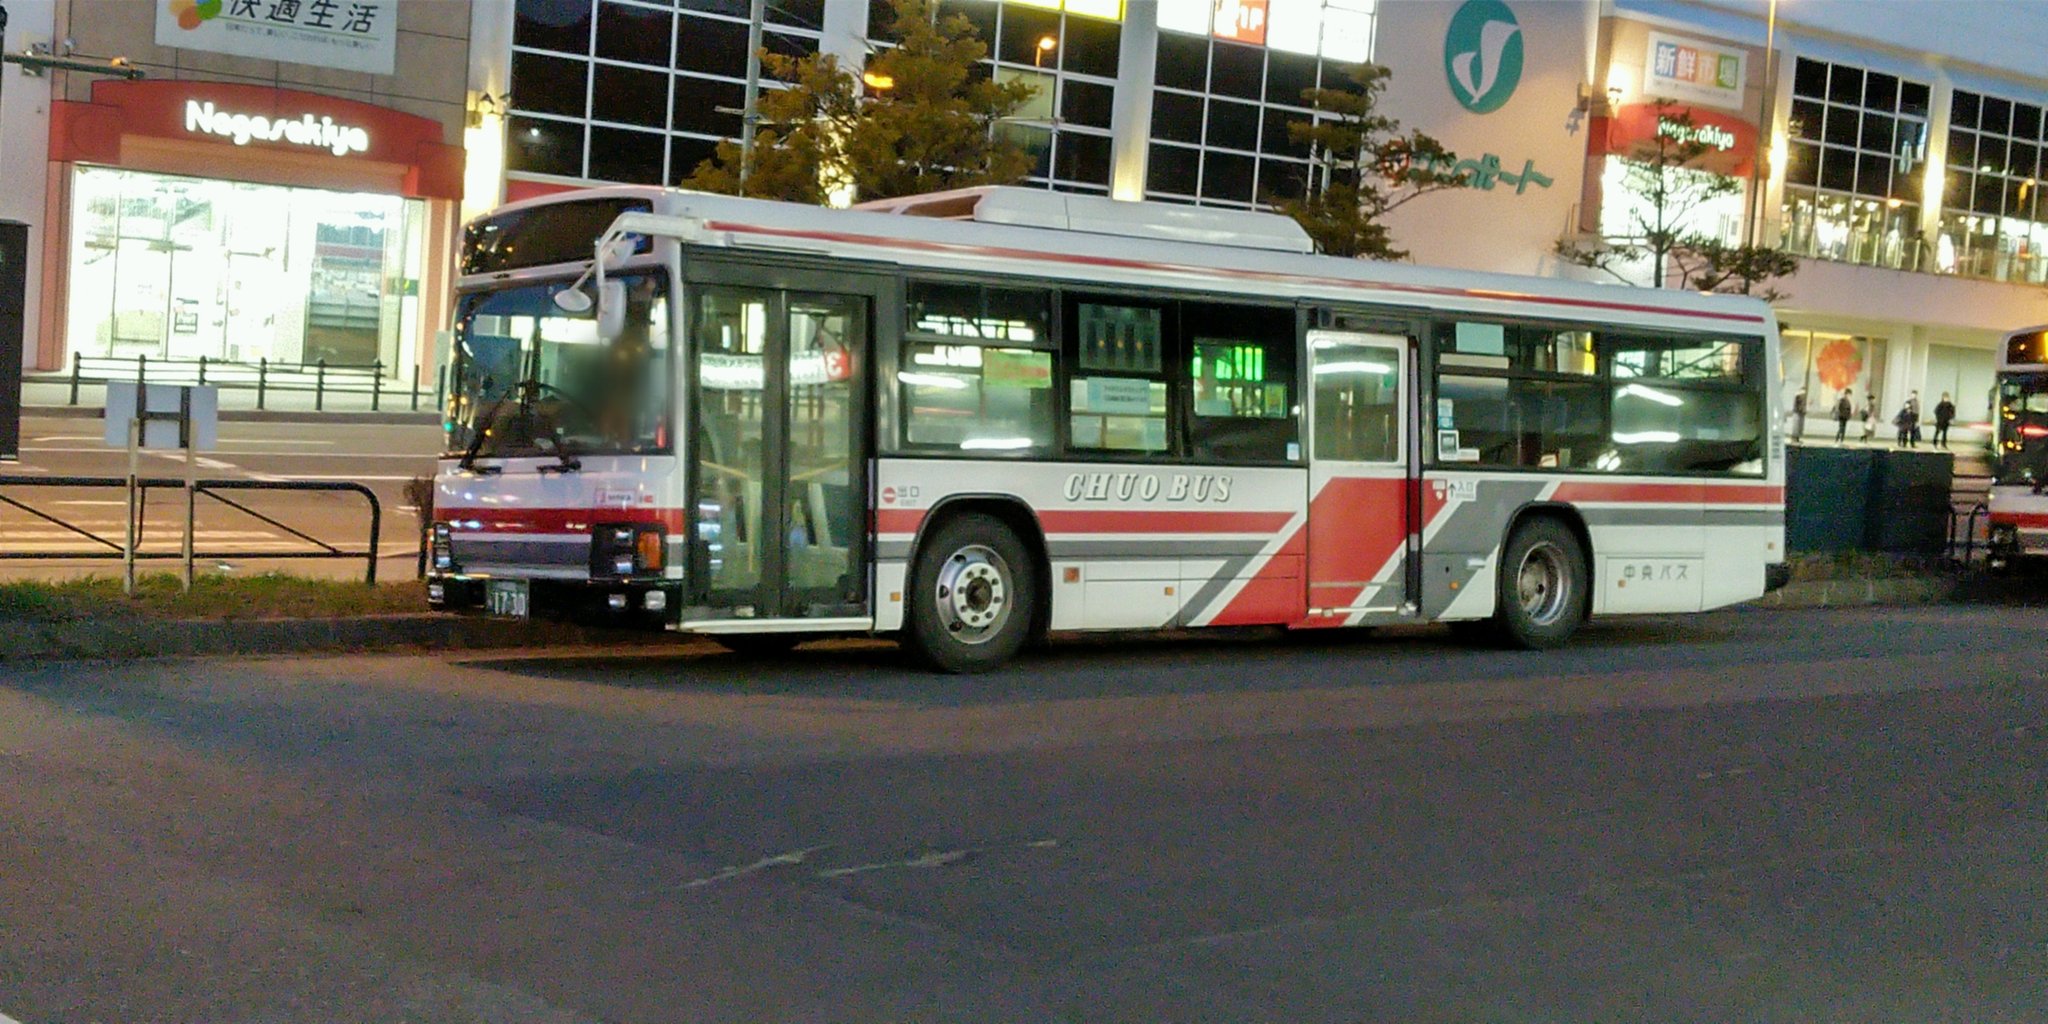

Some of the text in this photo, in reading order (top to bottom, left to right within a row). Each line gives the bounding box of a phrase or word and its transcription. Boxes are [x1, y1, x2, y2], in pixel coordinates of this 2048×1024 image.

[229, 0, 379, 33] 快適生活
[1655, 44, 1737, 88] 新鮮市場
[185, 99, 369, 157] Nagasakiya
[1063, 473, 1233, 503] CHUO BUS
[1623, 563, 1689, 581] 中央バス
